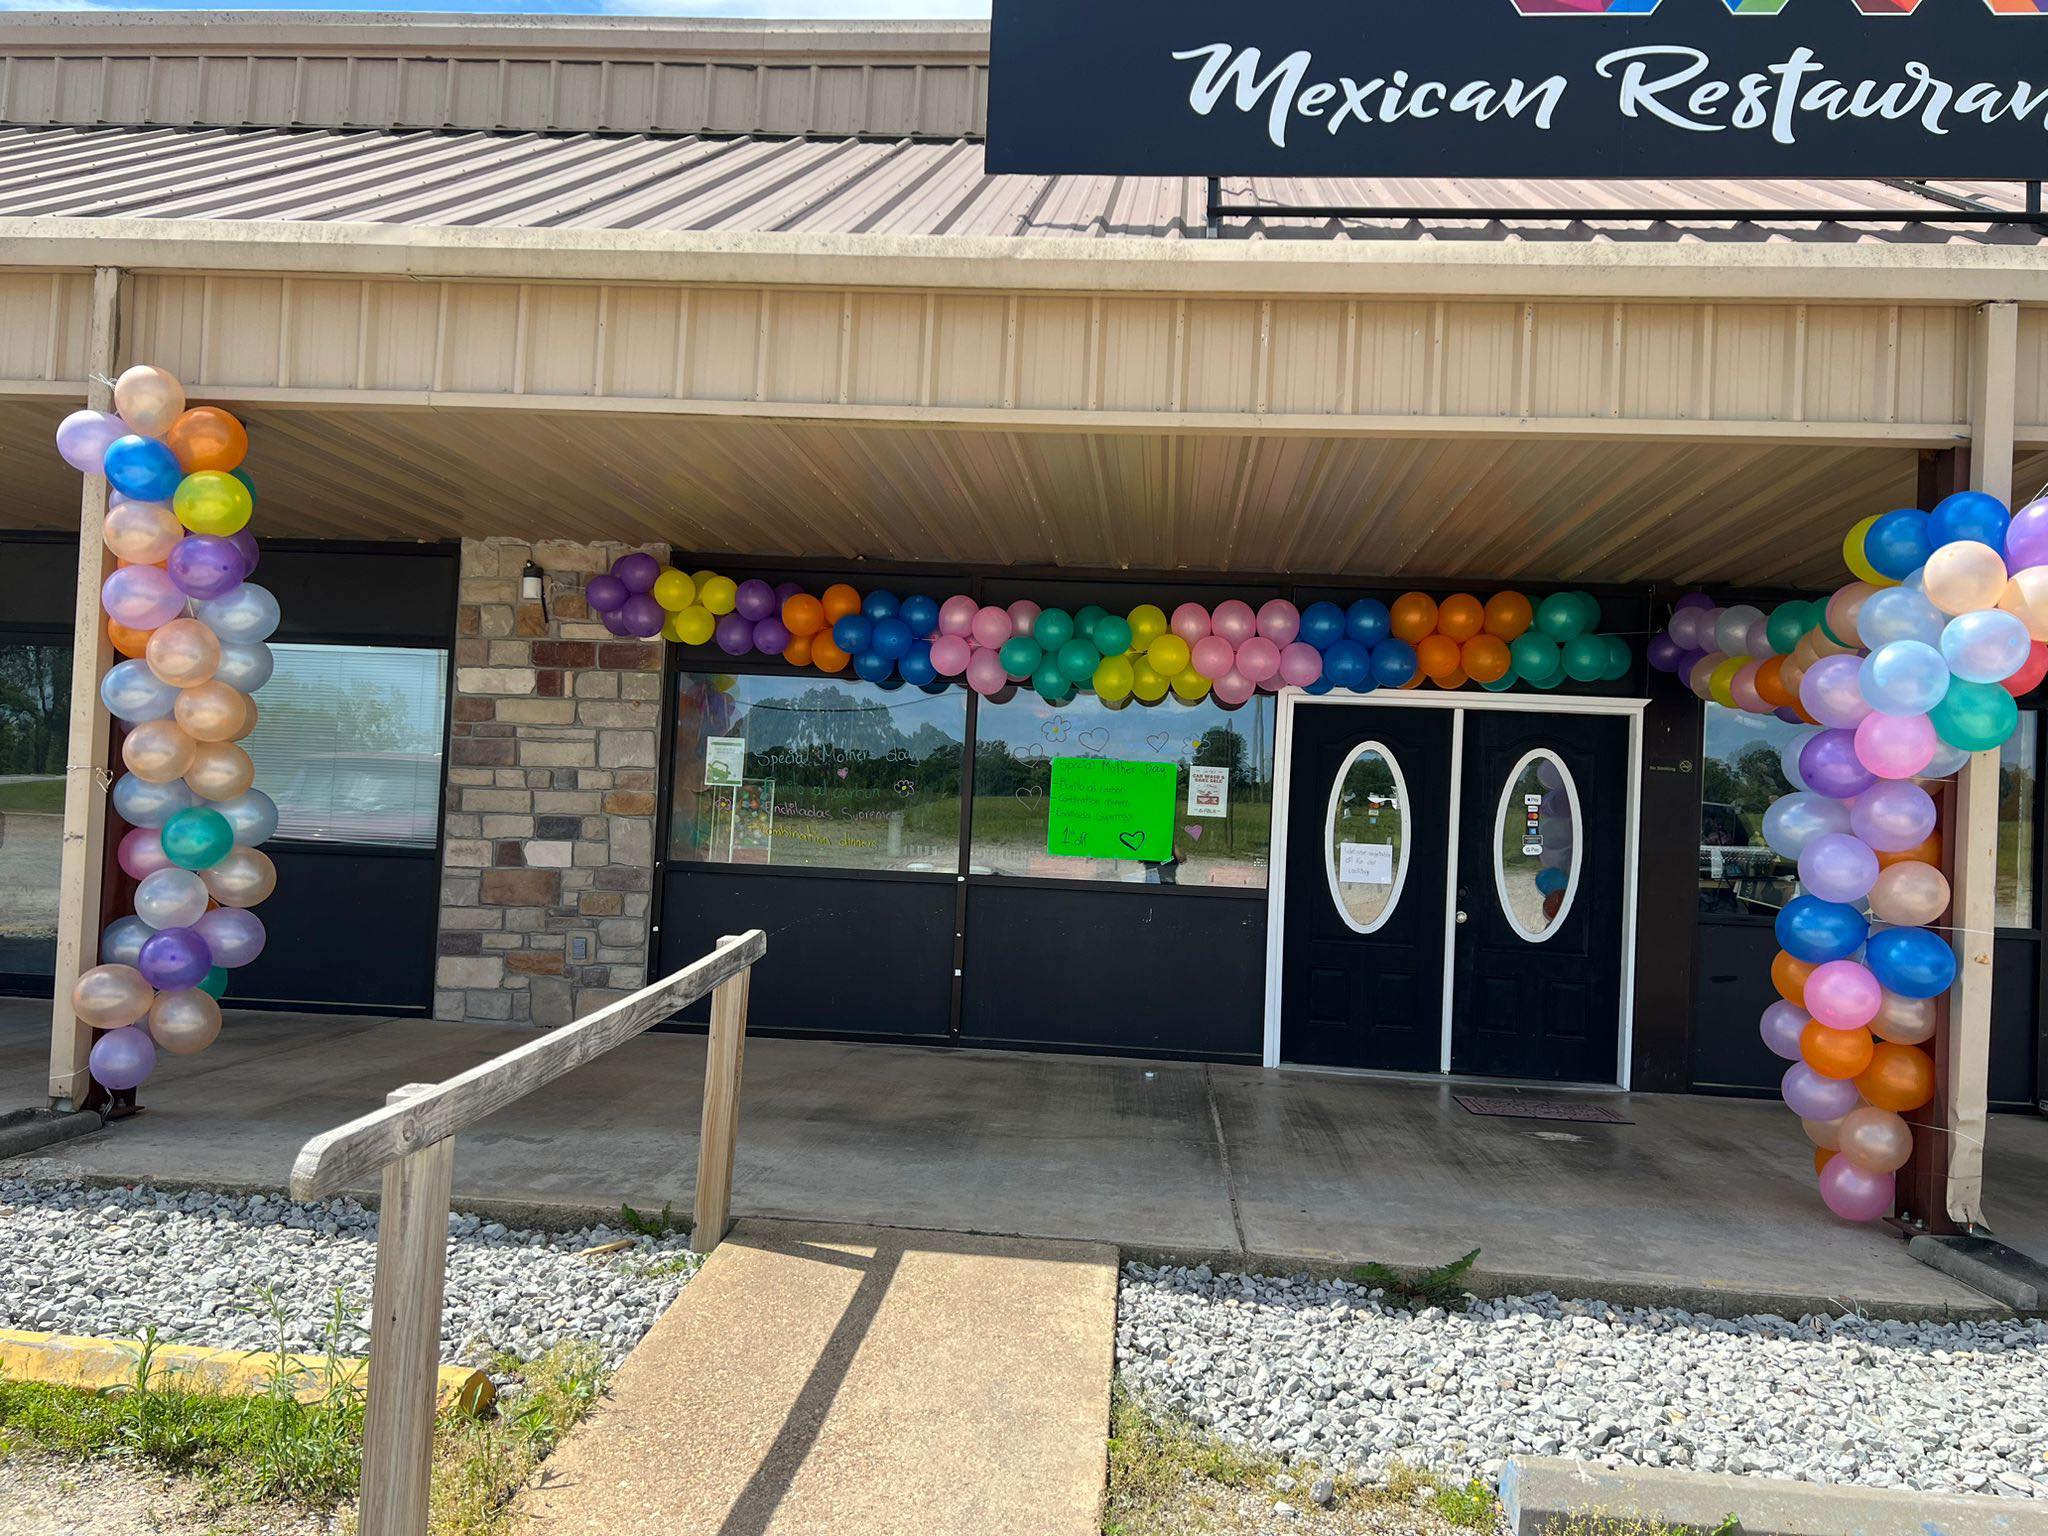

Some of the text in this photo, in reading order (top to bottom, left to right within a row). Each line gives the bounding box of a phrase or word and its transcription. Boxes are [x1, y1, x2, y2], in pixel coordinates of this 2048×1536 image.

[1171, 41, 1568, 149] Mexican
[755, 747, 810, 772] Special
[886, 741, 920, 767] day
[1102, 760, 1135, 775] Mother
[1145, 763, 1168, 777] Day
[765, 800, 833, 819] Enchiladas
